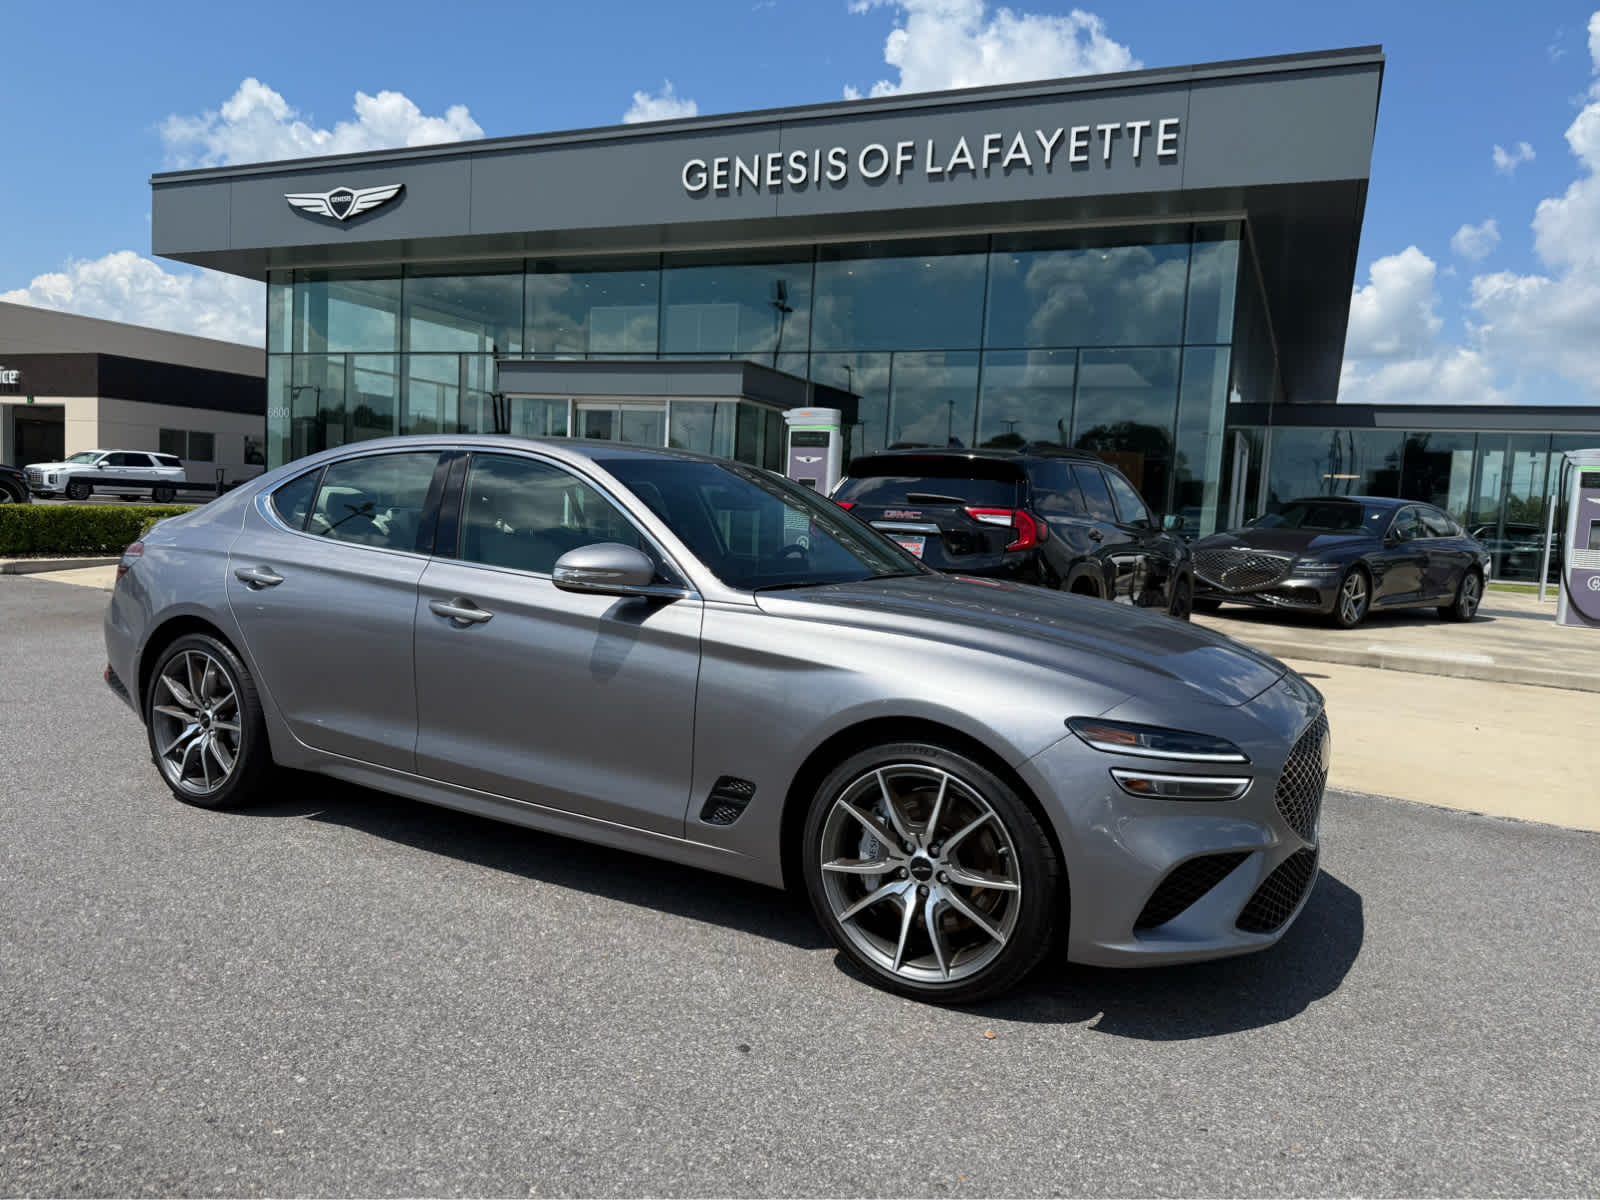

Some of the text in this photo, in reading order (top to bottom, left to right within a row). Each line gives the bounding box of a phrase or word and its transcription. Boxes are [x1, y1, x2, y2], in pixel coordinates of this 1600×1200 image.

[682, 118, 1180, 191] GENESIS OF LAFAYETTE
[884, 510, 922, 520] GMC
